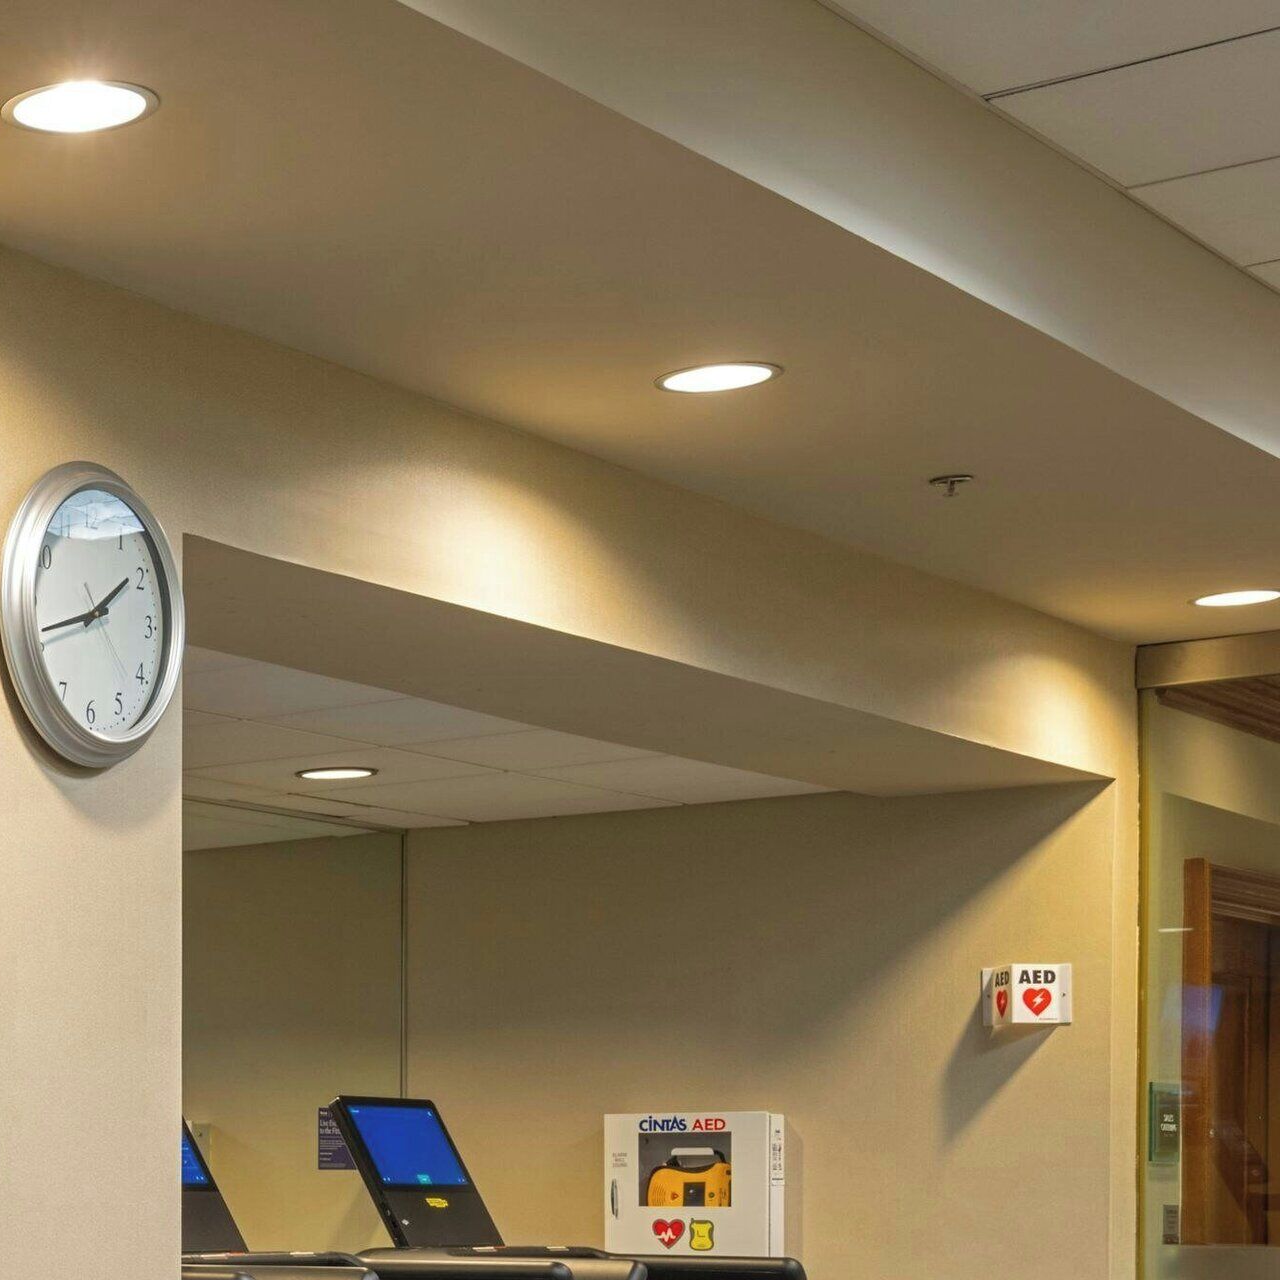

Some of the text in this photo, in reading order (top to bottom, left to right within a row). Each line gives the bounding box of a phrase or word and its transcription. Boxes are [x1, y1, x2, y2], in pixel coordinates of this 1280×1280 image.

[136, 567, 145, 590] 2
[144, 615, 153, 639] 3
[135, 662, 145, 685] 4
[59, 681, 67, 701] 7
[86, 700, 96, 724] 6
[114, 692, 123, 716] 5
[995, 971, 1009, 987] AED
[1019, 970, 1056, 984] AED
[692, 1119, 726, 1130] AED
